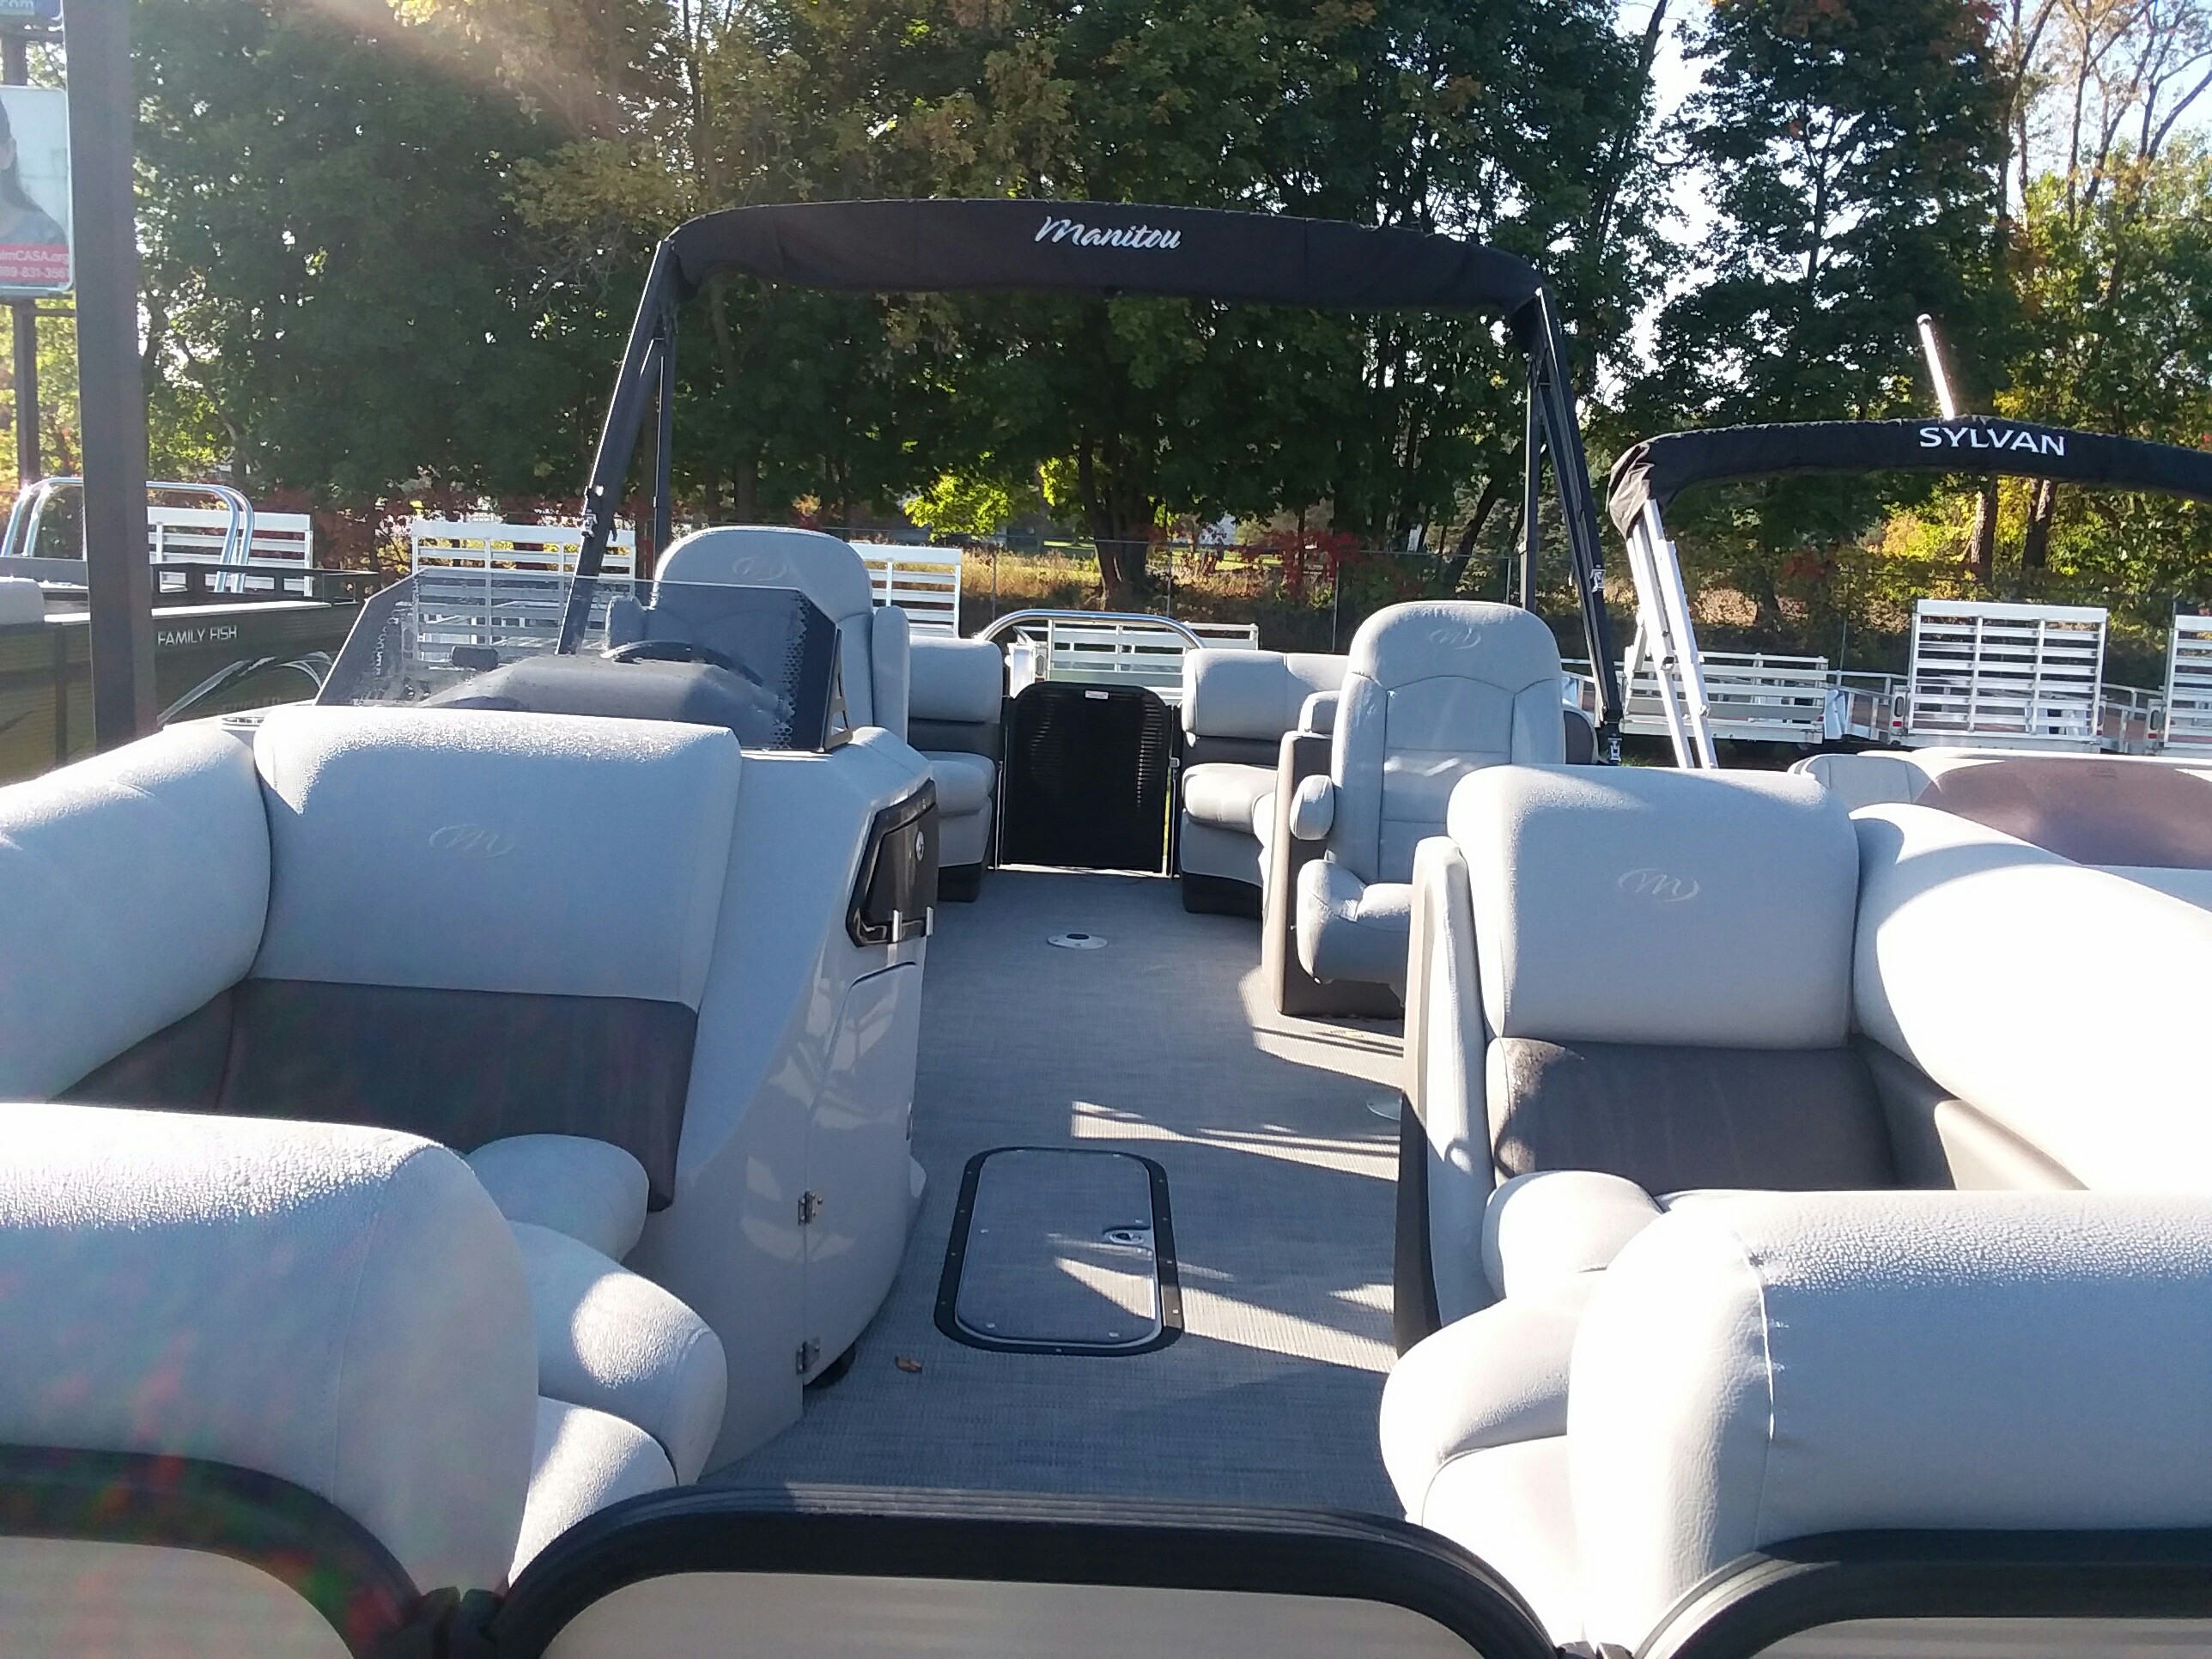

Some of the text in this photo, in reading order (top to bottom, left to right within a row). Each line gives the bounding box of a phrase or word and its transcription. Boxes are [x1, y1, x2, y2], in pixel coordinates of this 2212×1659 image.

[1035, 216, 1182, 249] Manitou
[1919, 427, 2065, 457] SYLVAN
[157, 624, 238, 646] FAMILY FISH
